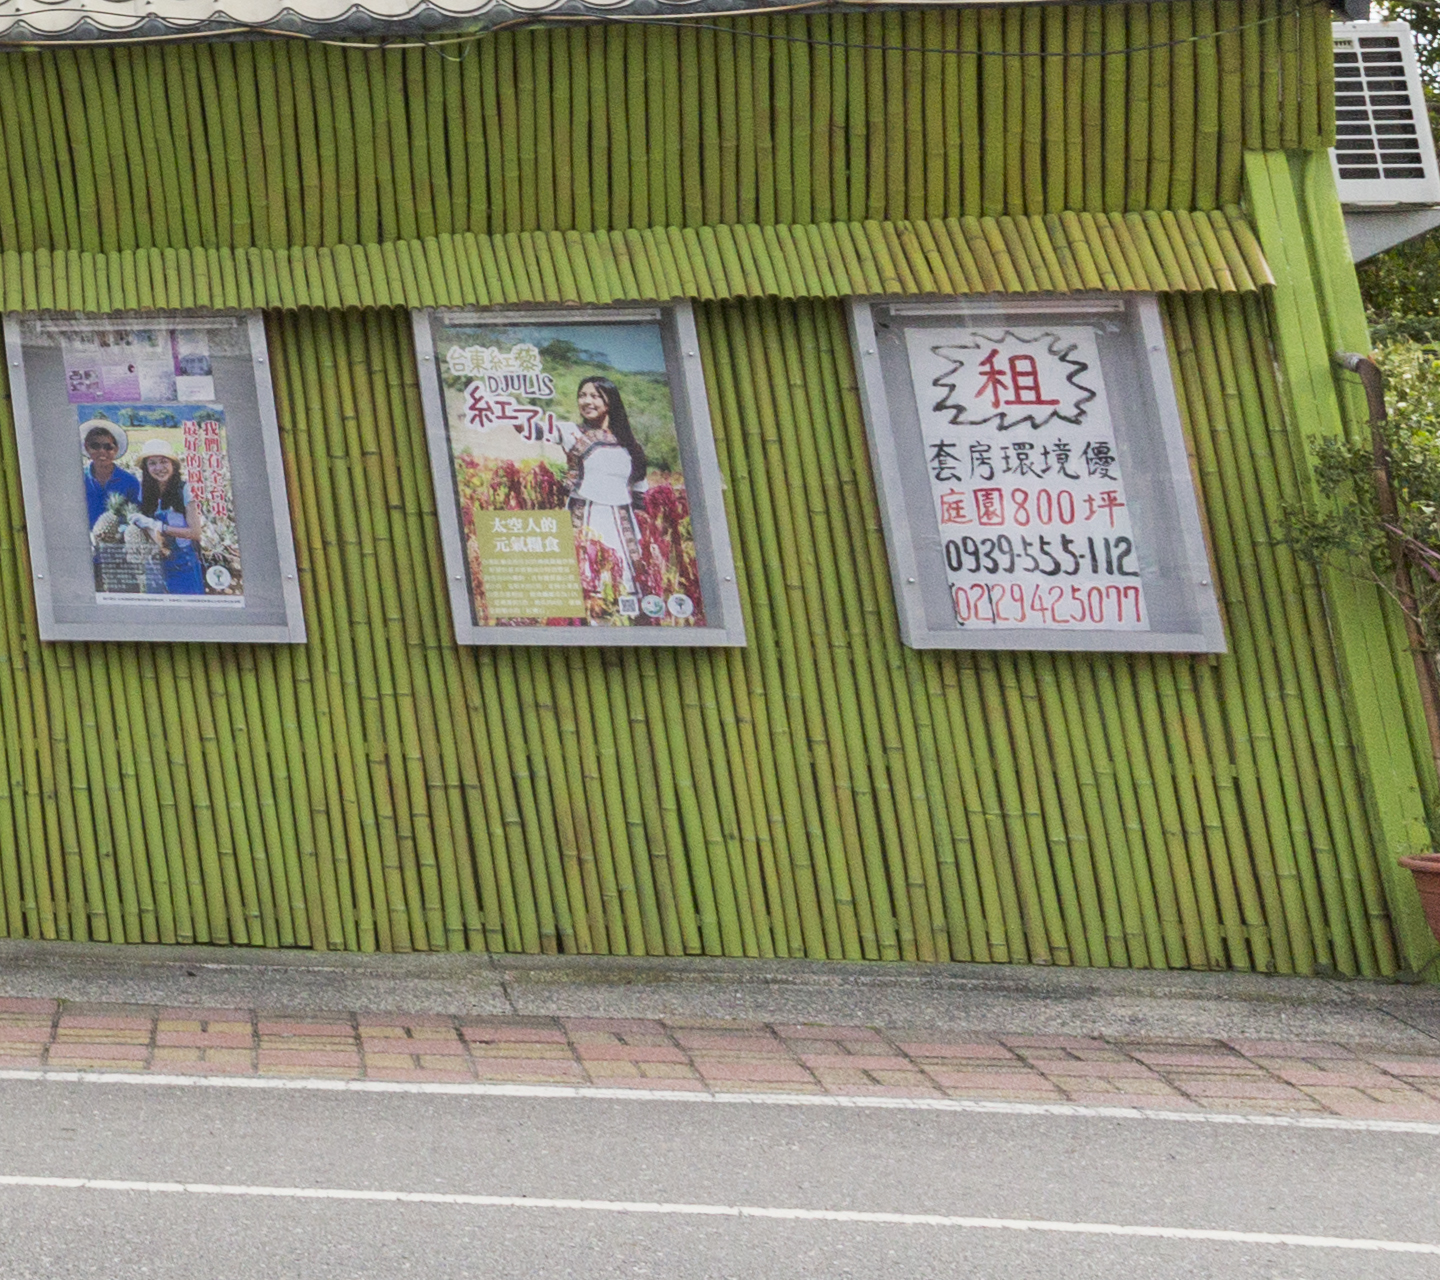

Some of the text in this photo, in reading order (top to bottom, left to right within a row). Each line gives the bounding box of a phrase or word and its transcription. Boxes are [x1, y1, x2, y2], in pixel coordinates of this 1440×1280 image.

[487, 373, 554, 397] DJULIS
[973, 347, 1061, 409] 租
[928, 437, 1118, 482] 套房環境優
[490, 516, 558, 534] 太空人的
[939, 487, 1126, 529] 庭園800坪
[944, 533, 1141, 578] 0939-555-112
